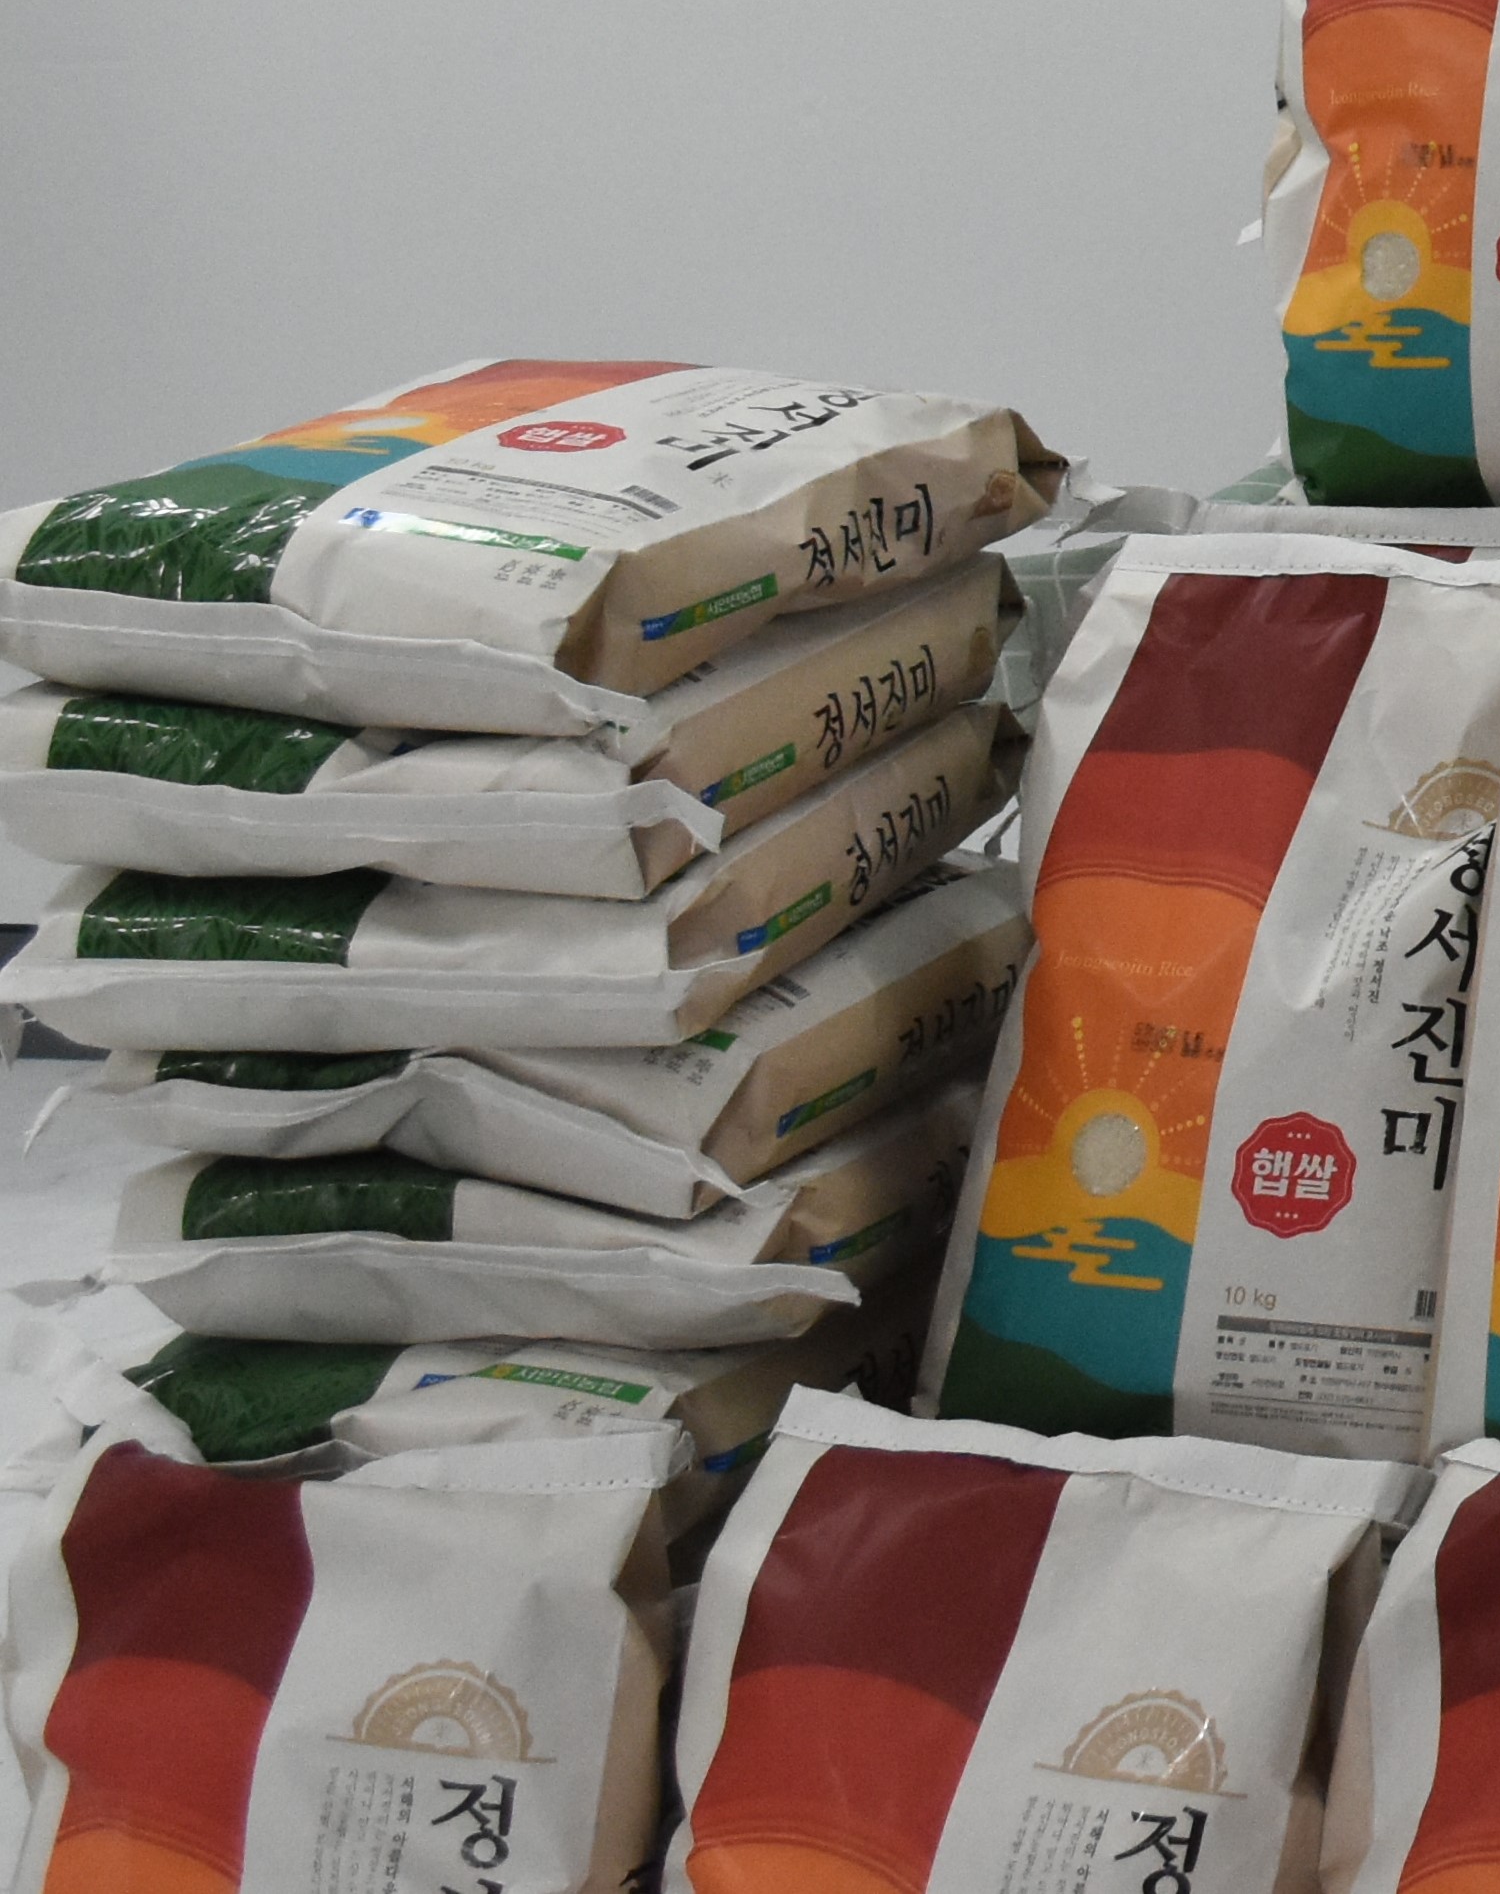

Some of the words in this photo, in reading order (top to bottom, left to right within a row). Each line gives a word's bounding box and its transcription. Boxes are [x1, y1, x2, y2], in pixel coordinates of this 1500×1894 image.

[517, 424, 611, 451] 햅쌀
[799, 483, 935, 588] 정서진미
[813, 644, 938, 770] 정서진미
[1251, 1146, 1339, 1202] 햅쌀
[1223, 1285, 1249, 1306] 10
[1252, 1286, 1278, 1311] kg
